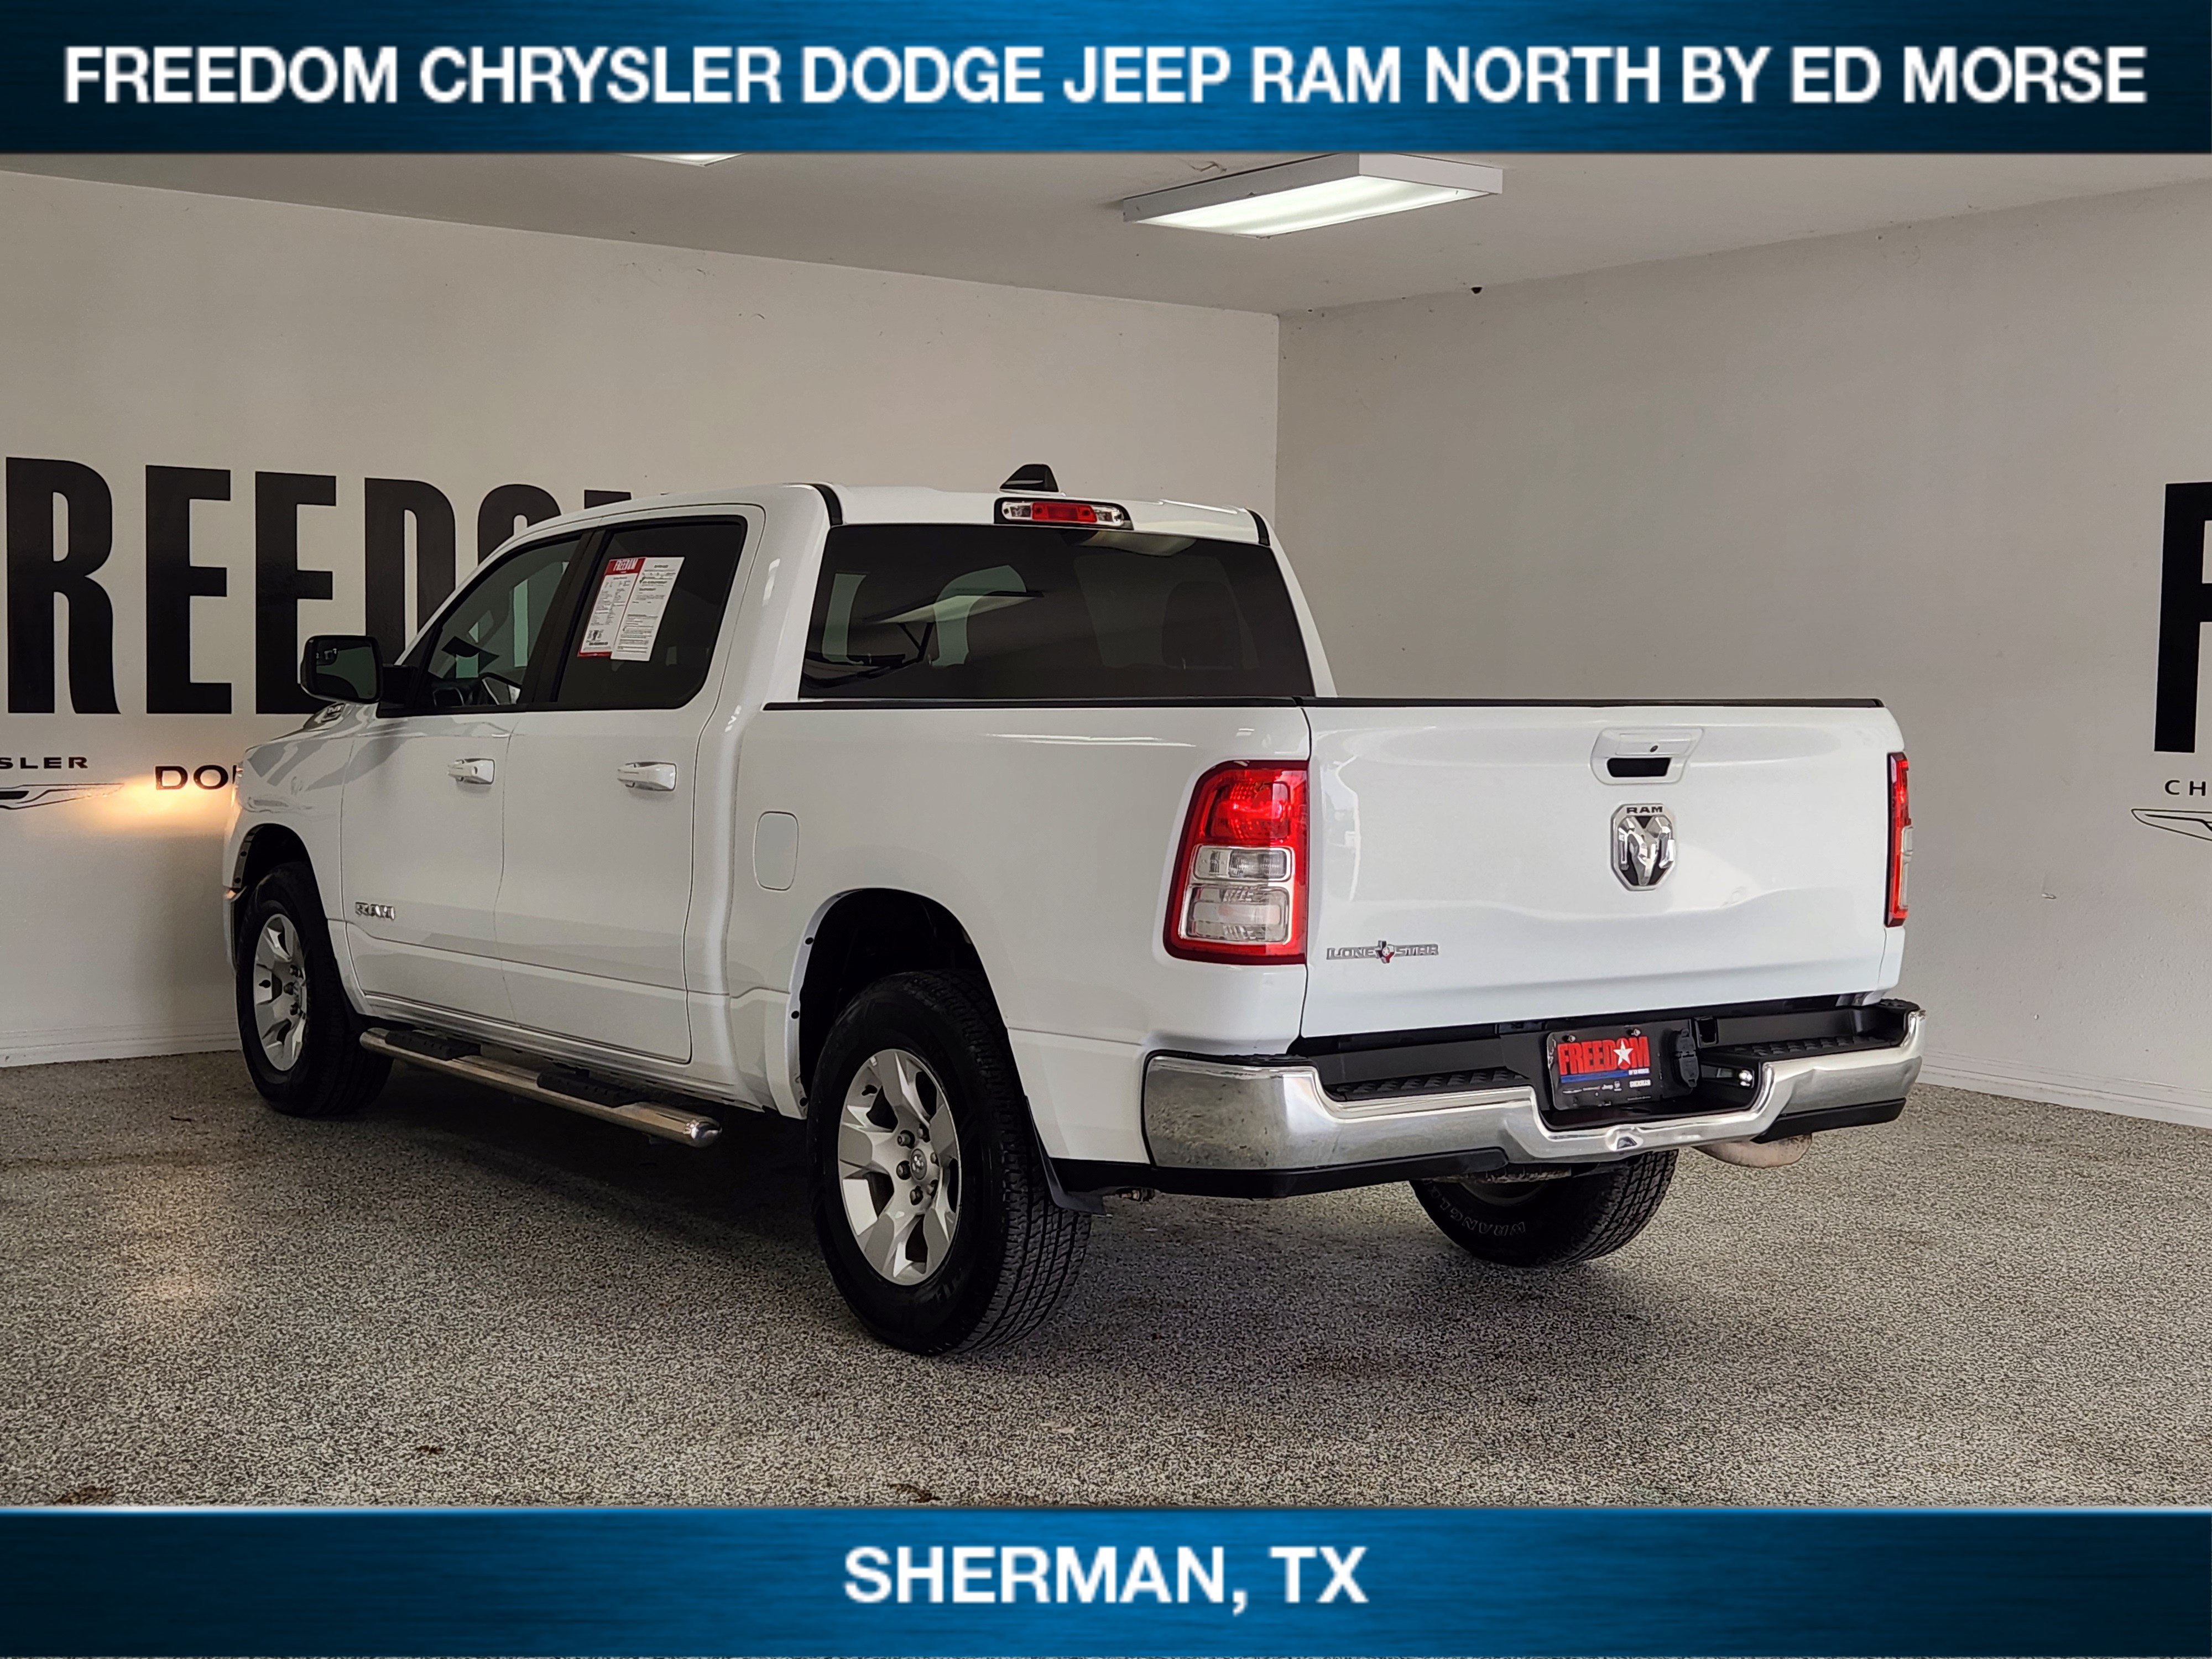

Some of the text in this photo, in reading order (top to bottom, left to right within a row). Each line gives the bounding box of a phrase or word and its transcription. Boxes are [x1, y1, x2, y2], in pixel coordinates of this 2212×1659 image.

[155, 765, 238, 790] DO
[355, 901, 395, 920] RAM
[1326, 943, 1439, 960] LONE STAR
[1557, 1036, 1651, 1076] FREEDOM
